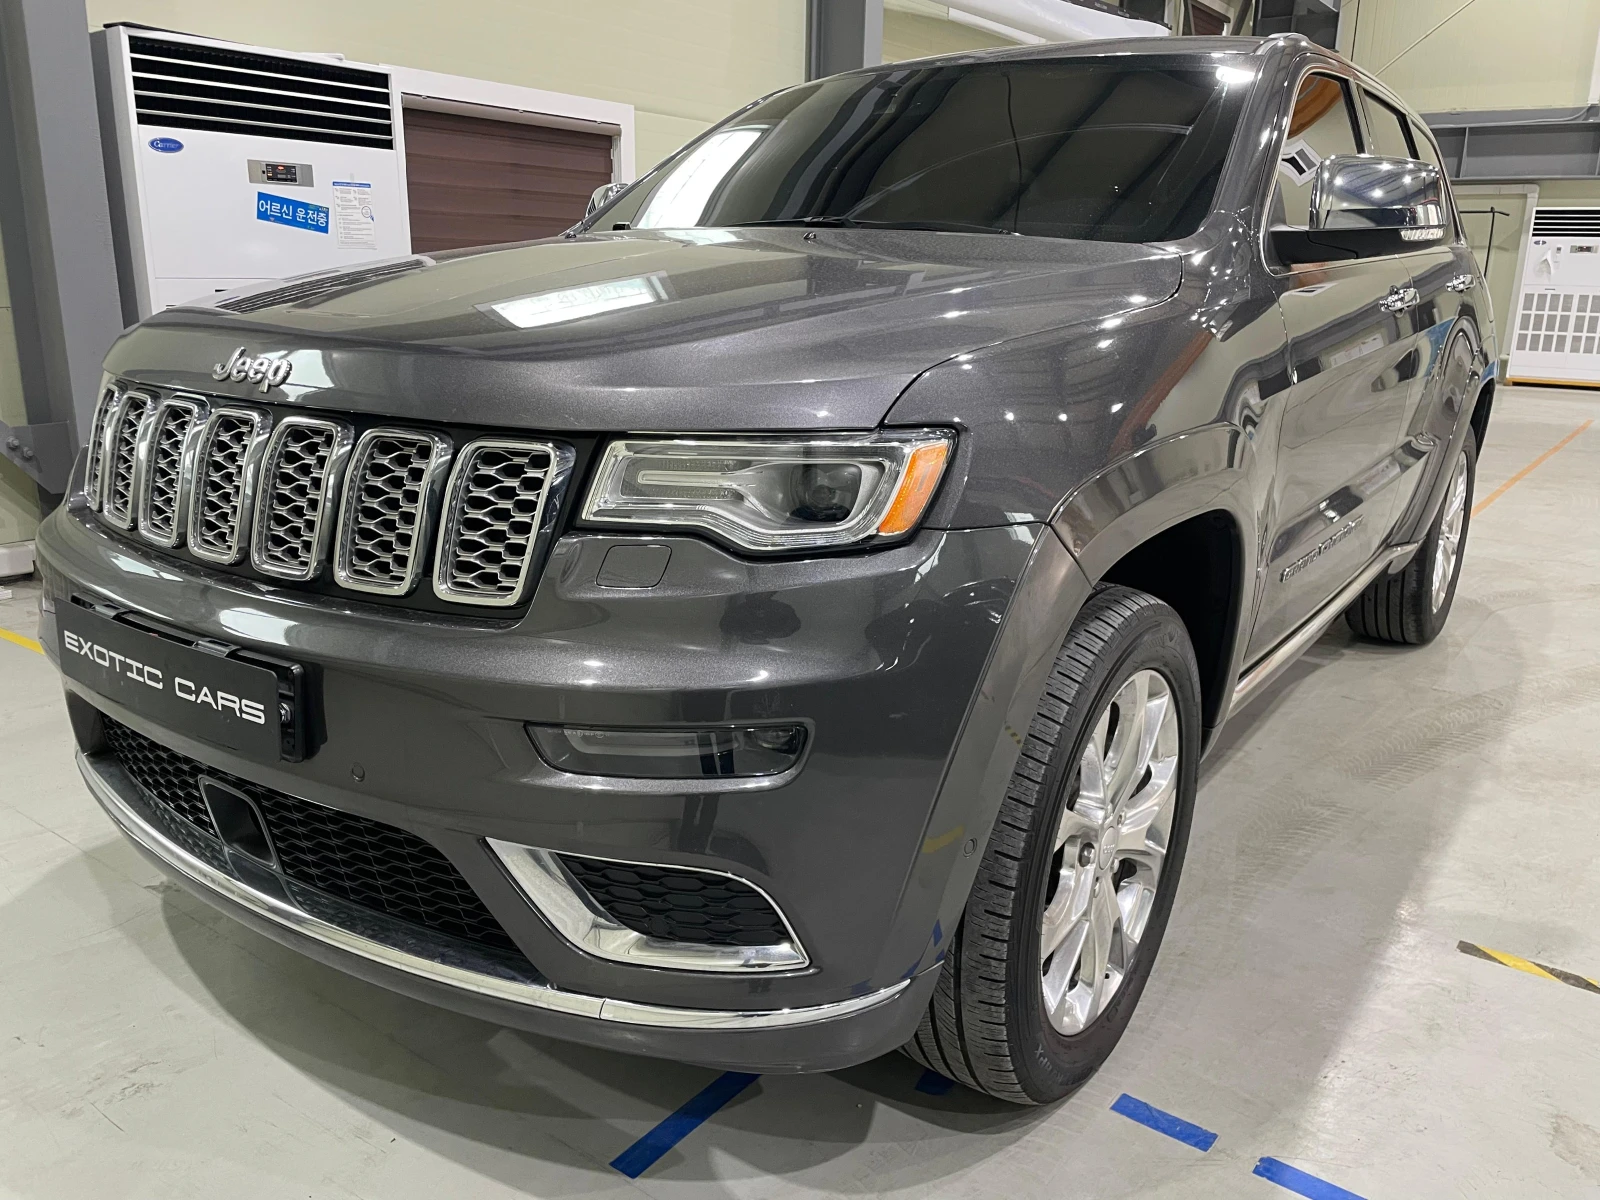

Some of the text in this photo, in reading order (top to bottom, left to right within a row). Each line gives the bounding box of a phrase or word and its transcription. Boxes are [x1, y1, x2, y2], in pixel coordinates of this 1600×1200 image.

[259, 200, 328, 227] 어르신 운전중
[212, 346, 293, 393] Jeep
[64, 630, 265, 724] EXOTIC CARS
